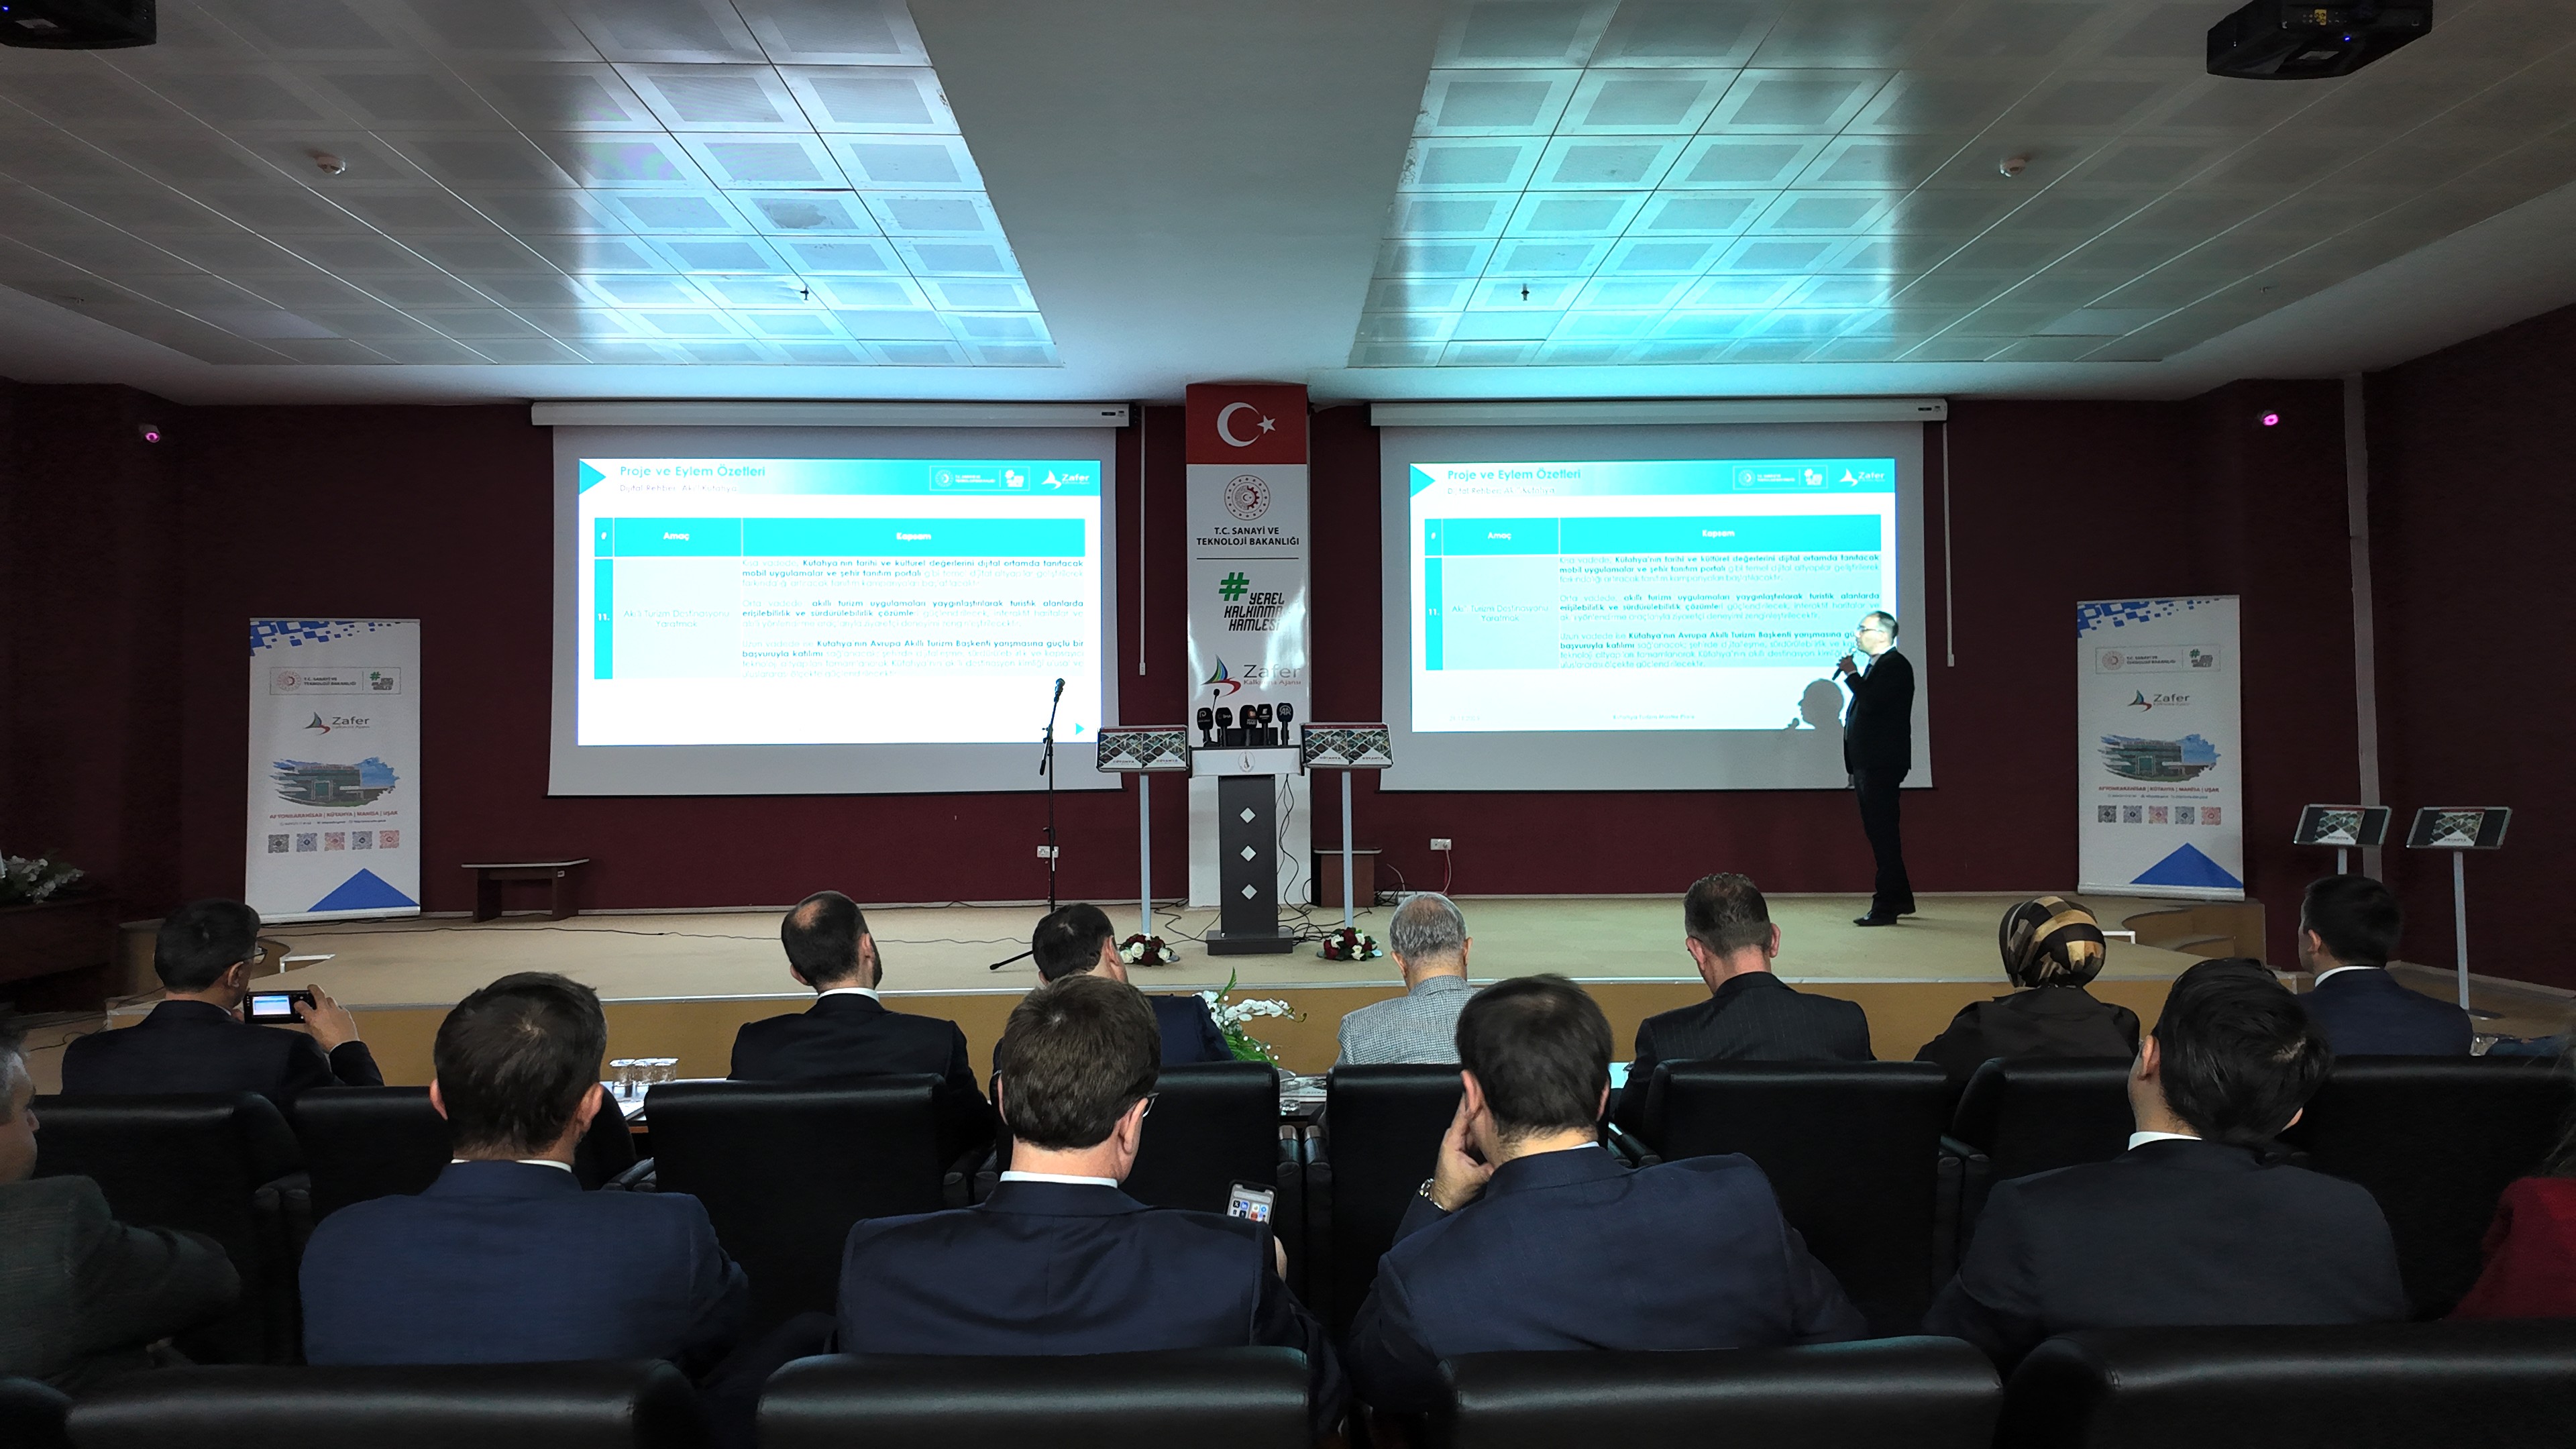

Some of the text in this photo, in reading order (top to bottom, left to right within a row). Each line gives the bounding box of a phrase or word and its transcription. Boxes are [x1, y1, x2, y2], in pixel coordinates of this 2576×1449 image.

[620, 464, 765, 478] Proje ve Eylem Özetleri
[1448, 467, 1581, 482] Proje ve Eylem Özetleri
[1232, 526, 1265, 535] SANAYİ
[1703, 530, 1735, 538] Kapsam
[663, 533, 932, 541] Amaç Kapsam
[1197, 537, 1299, 545] TEKNOLOJİ BAKANLIĞI
[1615, 556, 1662, 565] Kütahya'nın
[1585, 566, 1634, 574] uygulamalar
[1224, 606, 1283, 618] KALKINMA
[1629, 632, 1675, 641] Kütahya'nın
[1678, 632, 1707, 640] Avrupa
[1758, 631, 1791, 639] Başkenti
[1794, 631, 1841, 639] yarışmasına
[956, 640, 991, 649] Başkenti
[994, 640, 1043, 649] yarışmasına
[1560, 642, 1603, 650] başvuruyla
[742, 651, 790, 659] başvuruyla
[1243, 664, 1300, 678] Zafer
[2153, 694, 2190, 702] Zafer
[332, 716, 370, 725] Zafer
